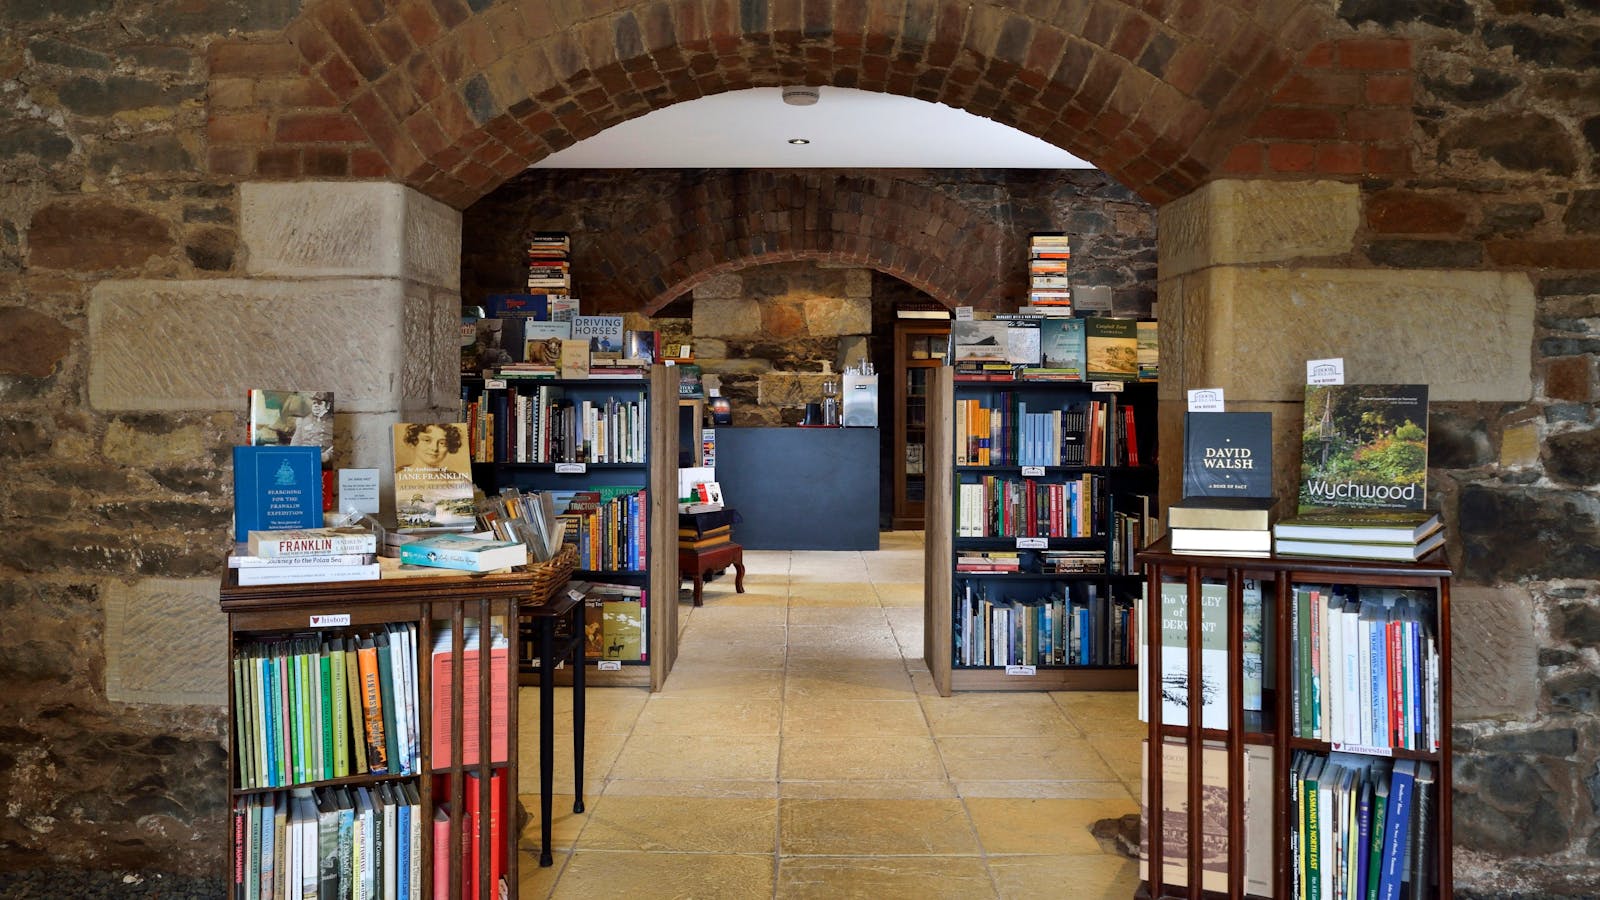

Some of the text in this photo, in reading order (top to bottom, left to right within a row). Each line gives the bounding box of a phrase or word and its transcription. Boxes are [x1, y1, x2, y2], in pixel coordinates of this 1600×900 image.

[575, 318, 621, 327] DRIVING
[575, 326, 618, 335] HORSES
[1206, 448, 1251, 458] DAVID
[1204, 458, 1254, 469] WALSH
[1307, 480, 1415, 502] Wychwood
[279, 540, 332, 552] FRANKLIN
[1173, 608, 1184, 617] of
[1309, 790, 1318, 829] TASMANIA'S
